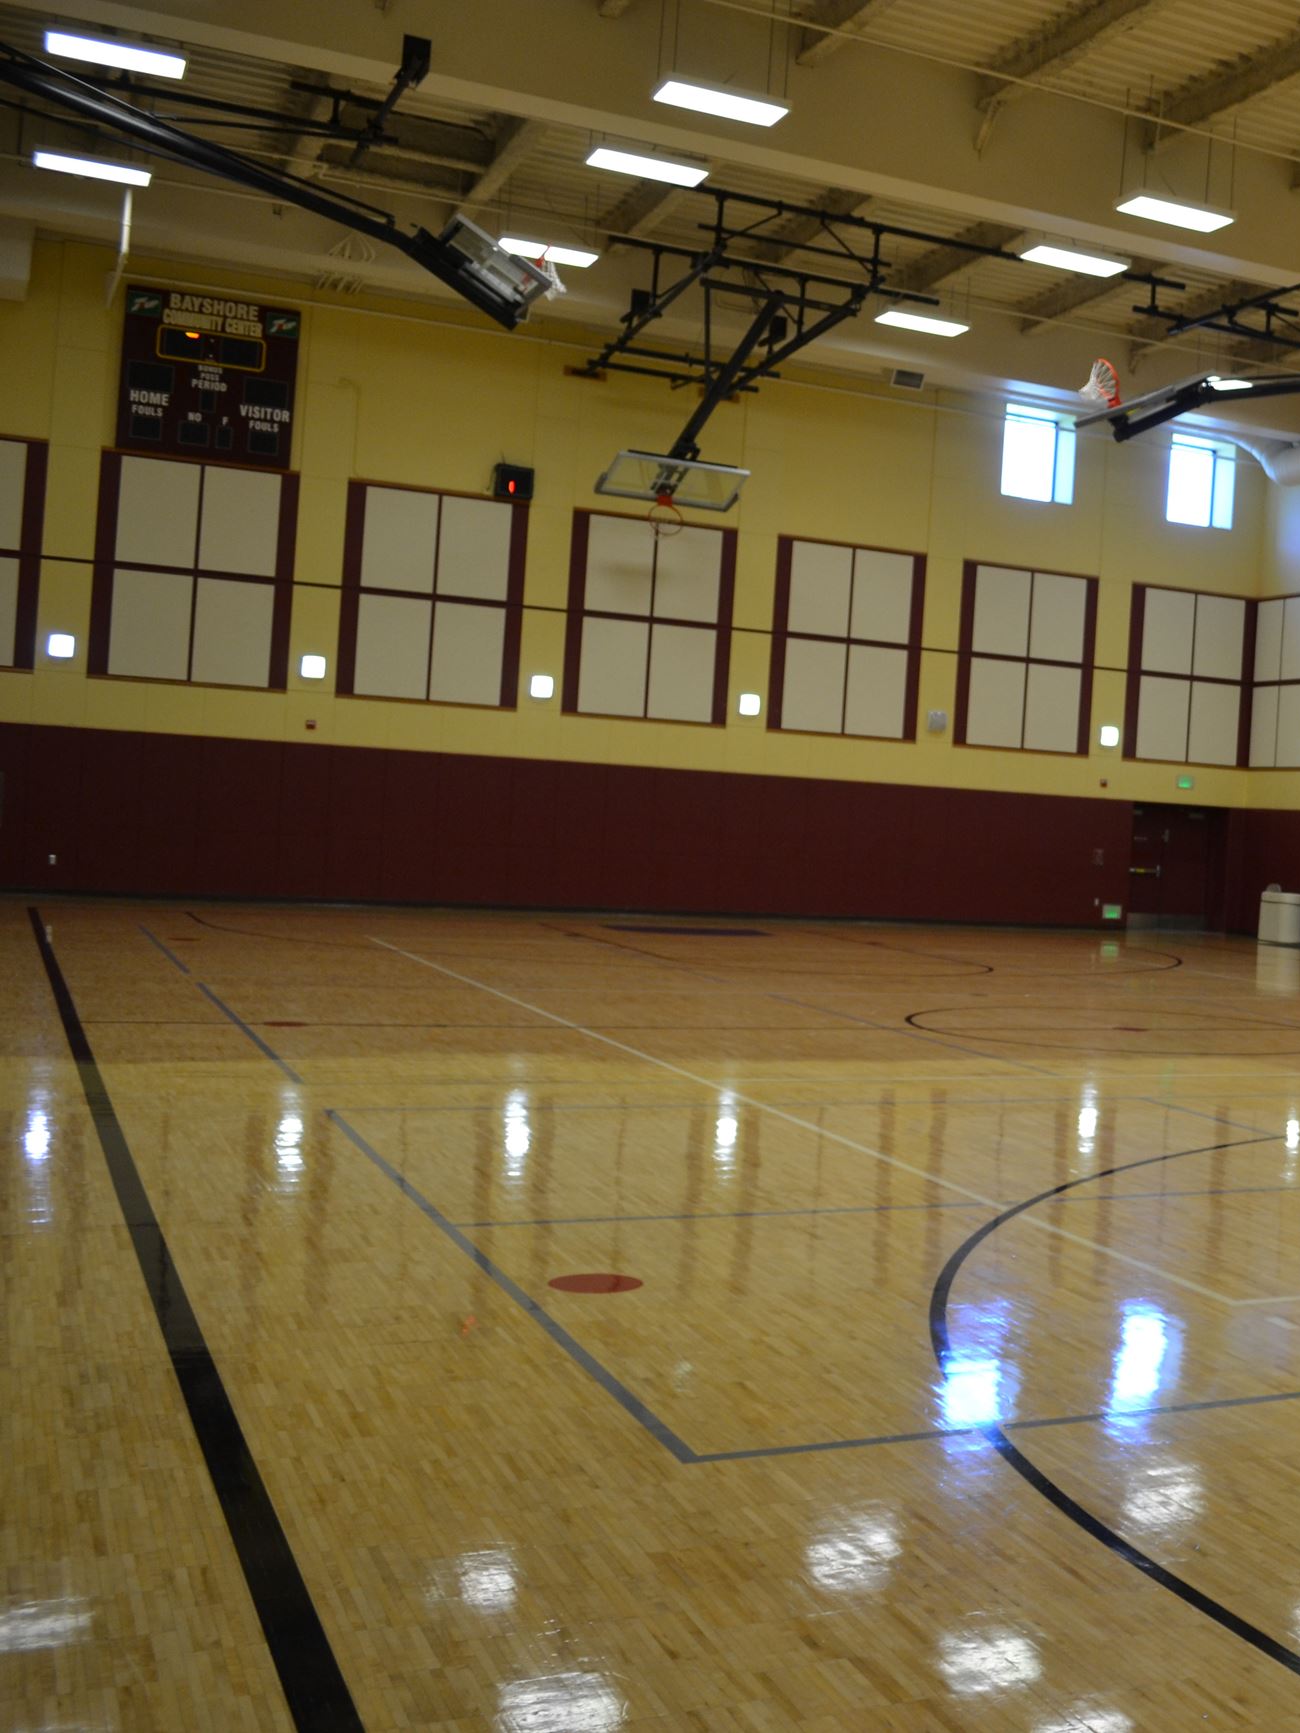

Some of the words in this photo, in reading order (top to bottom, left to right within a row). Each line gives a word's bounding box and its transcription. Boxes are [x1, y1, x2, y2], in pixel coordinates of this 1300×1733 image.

[169, 294, 259, 320] BAYSHORE
[225, 320, 263, 337] CENTER
[191, 379, 228, 392] PERIOD
[129, 390, 170, 406] HOME
[131, 405, 163, 417] FOULS
[187, 412, 202, 423] NO
[239, 405, 290, 423] VISITOR
[222, 417, 229, 426] F
[249, 421, 279, 433] FOULS
